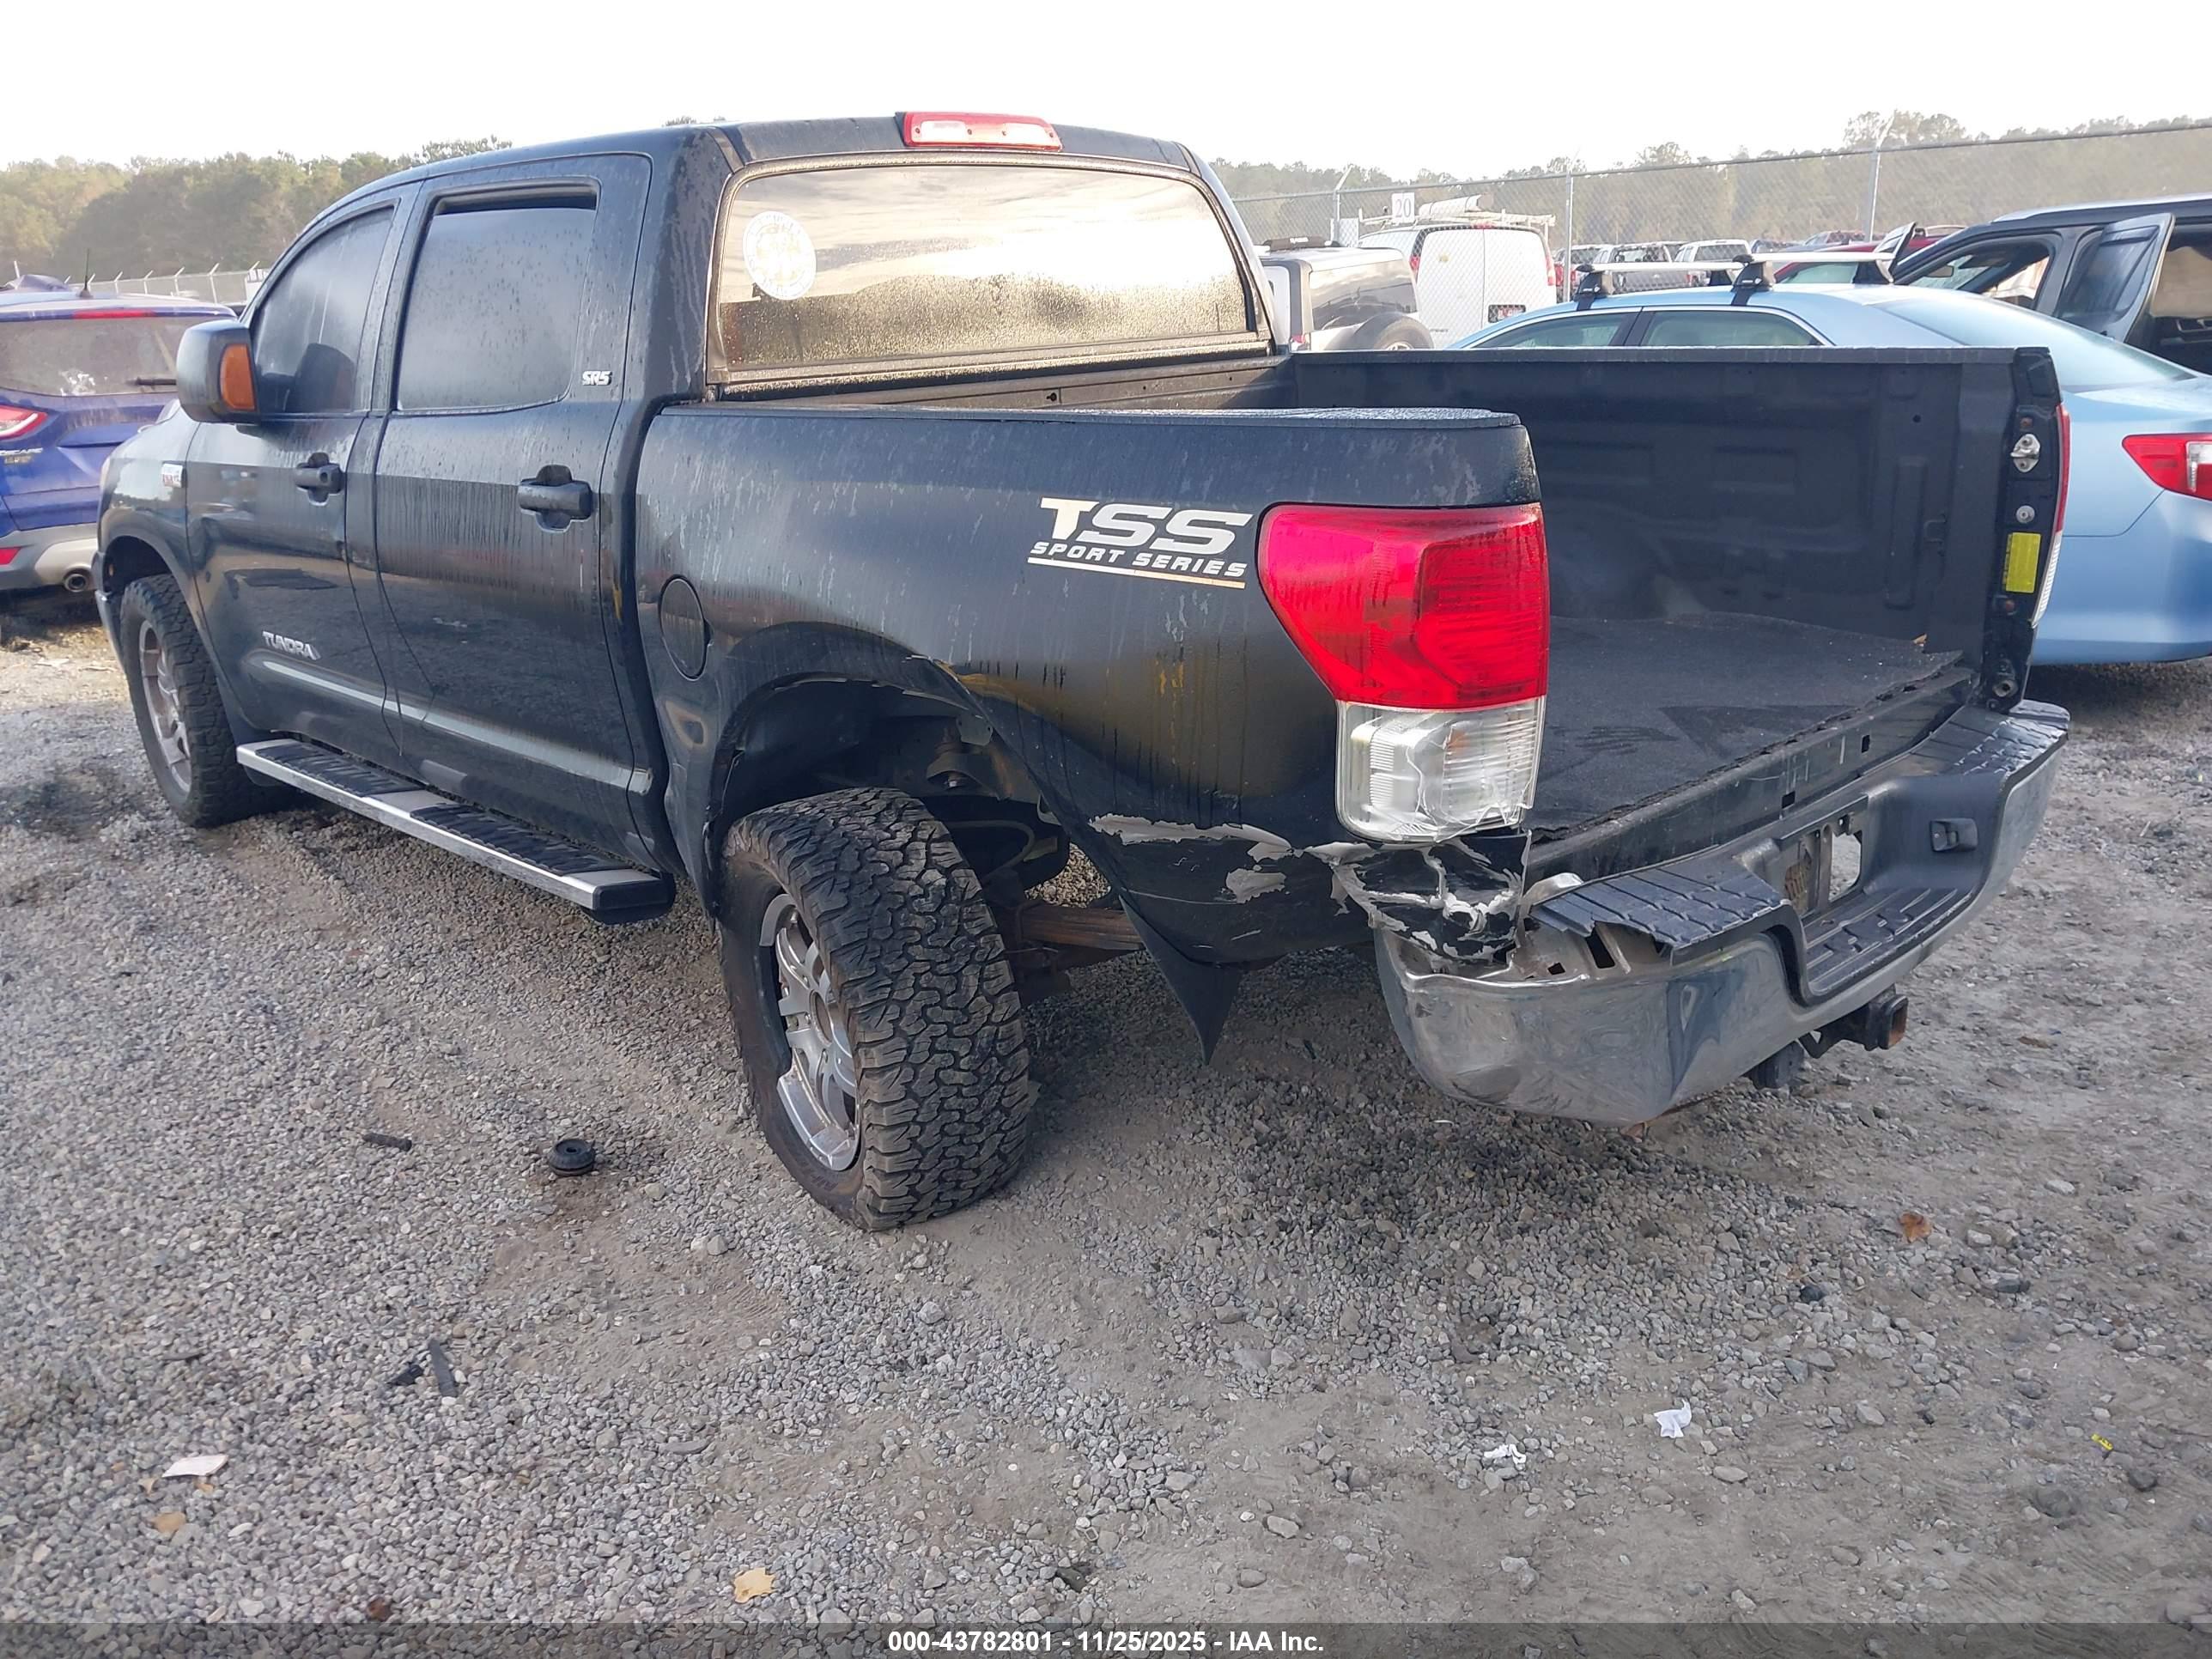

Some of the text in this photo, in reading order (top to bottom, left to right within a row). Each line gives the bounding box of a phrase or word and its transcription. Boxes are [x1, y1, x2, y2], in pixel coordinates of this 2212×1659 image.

[1395, 198, 1412, 218] 20
[582, 370, 612, 386] SR5
[1040, 496, 1254, 555] TSS
[1030, 541, 1248, 578] SPORT SERIES
[261, 630, 319, 661] TUNDRA
